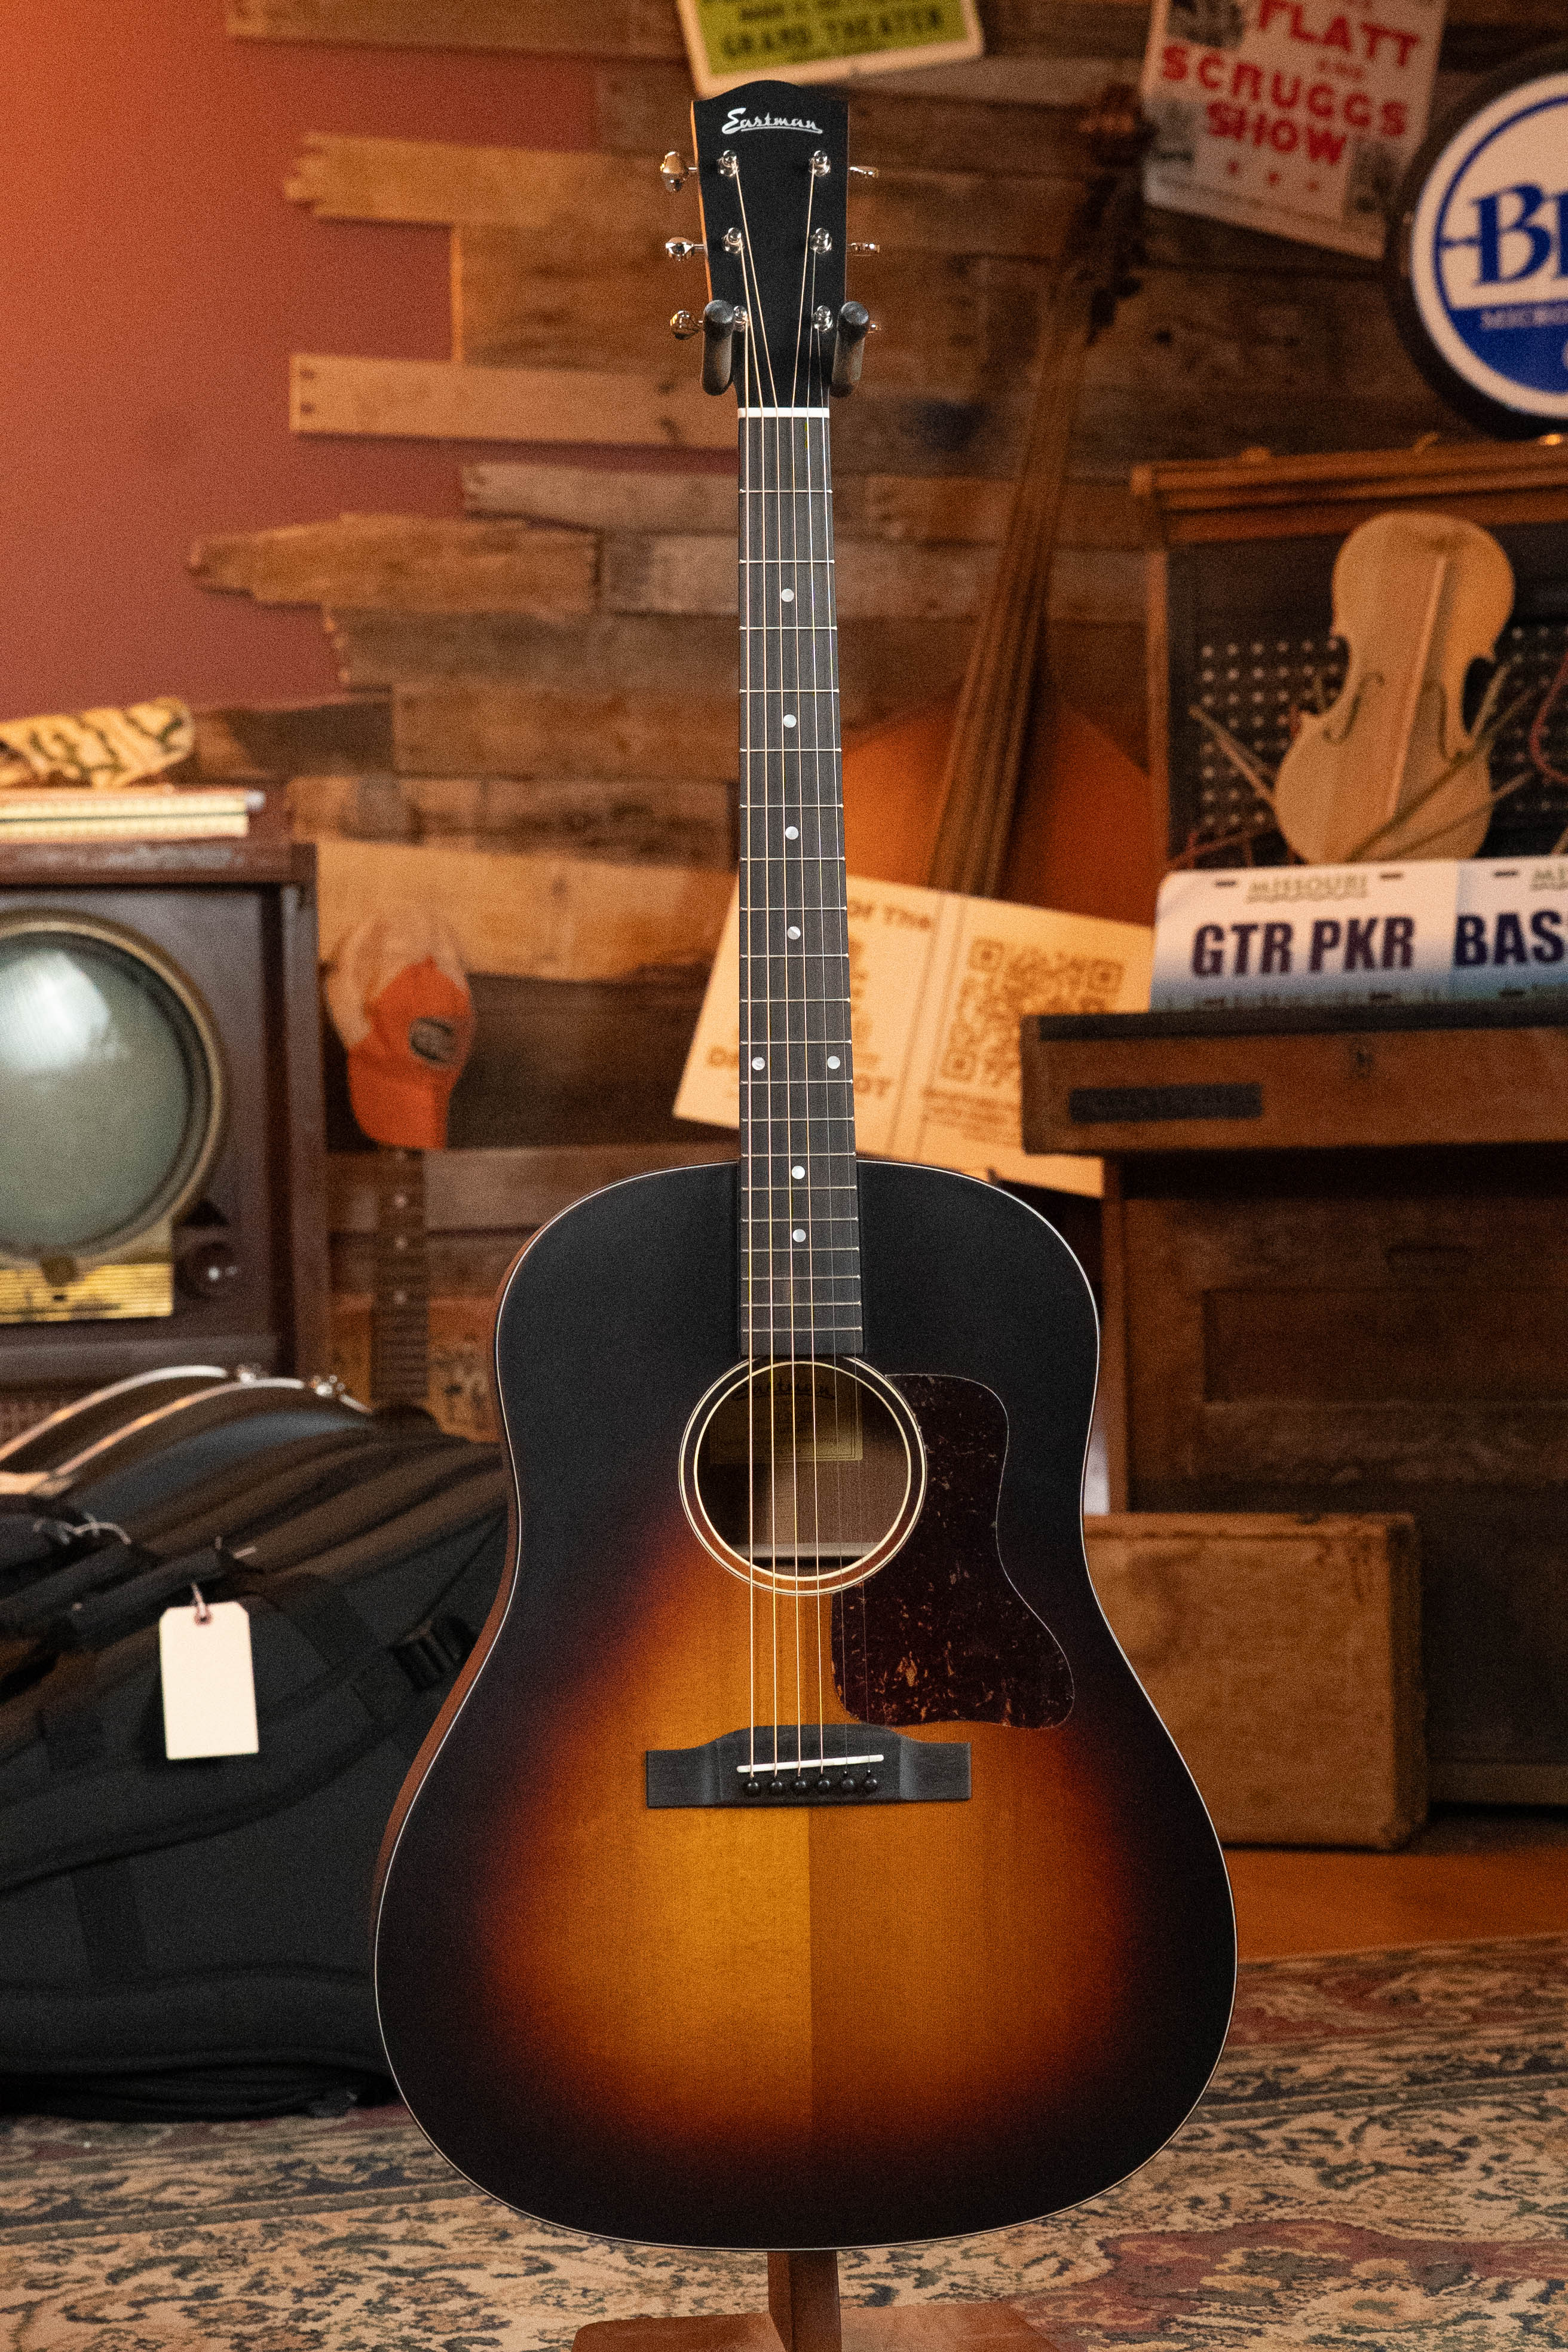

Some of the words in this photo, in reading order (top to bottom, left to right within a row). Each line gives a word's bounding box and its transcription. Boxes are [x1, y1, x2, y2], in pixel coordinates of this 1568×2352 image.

[1257, 0, 1421, 67] FLATT
[721, 107, 822, 134] Eastman
[1161, 44, 1409, 137] SCRUGGS
[1206, 100, 1348, 166] SHOW
[1469, 180, 1568, 287] B
[1193, 922, 1294, 976] GTR
[1310, 915, 1416, 972] PKR
